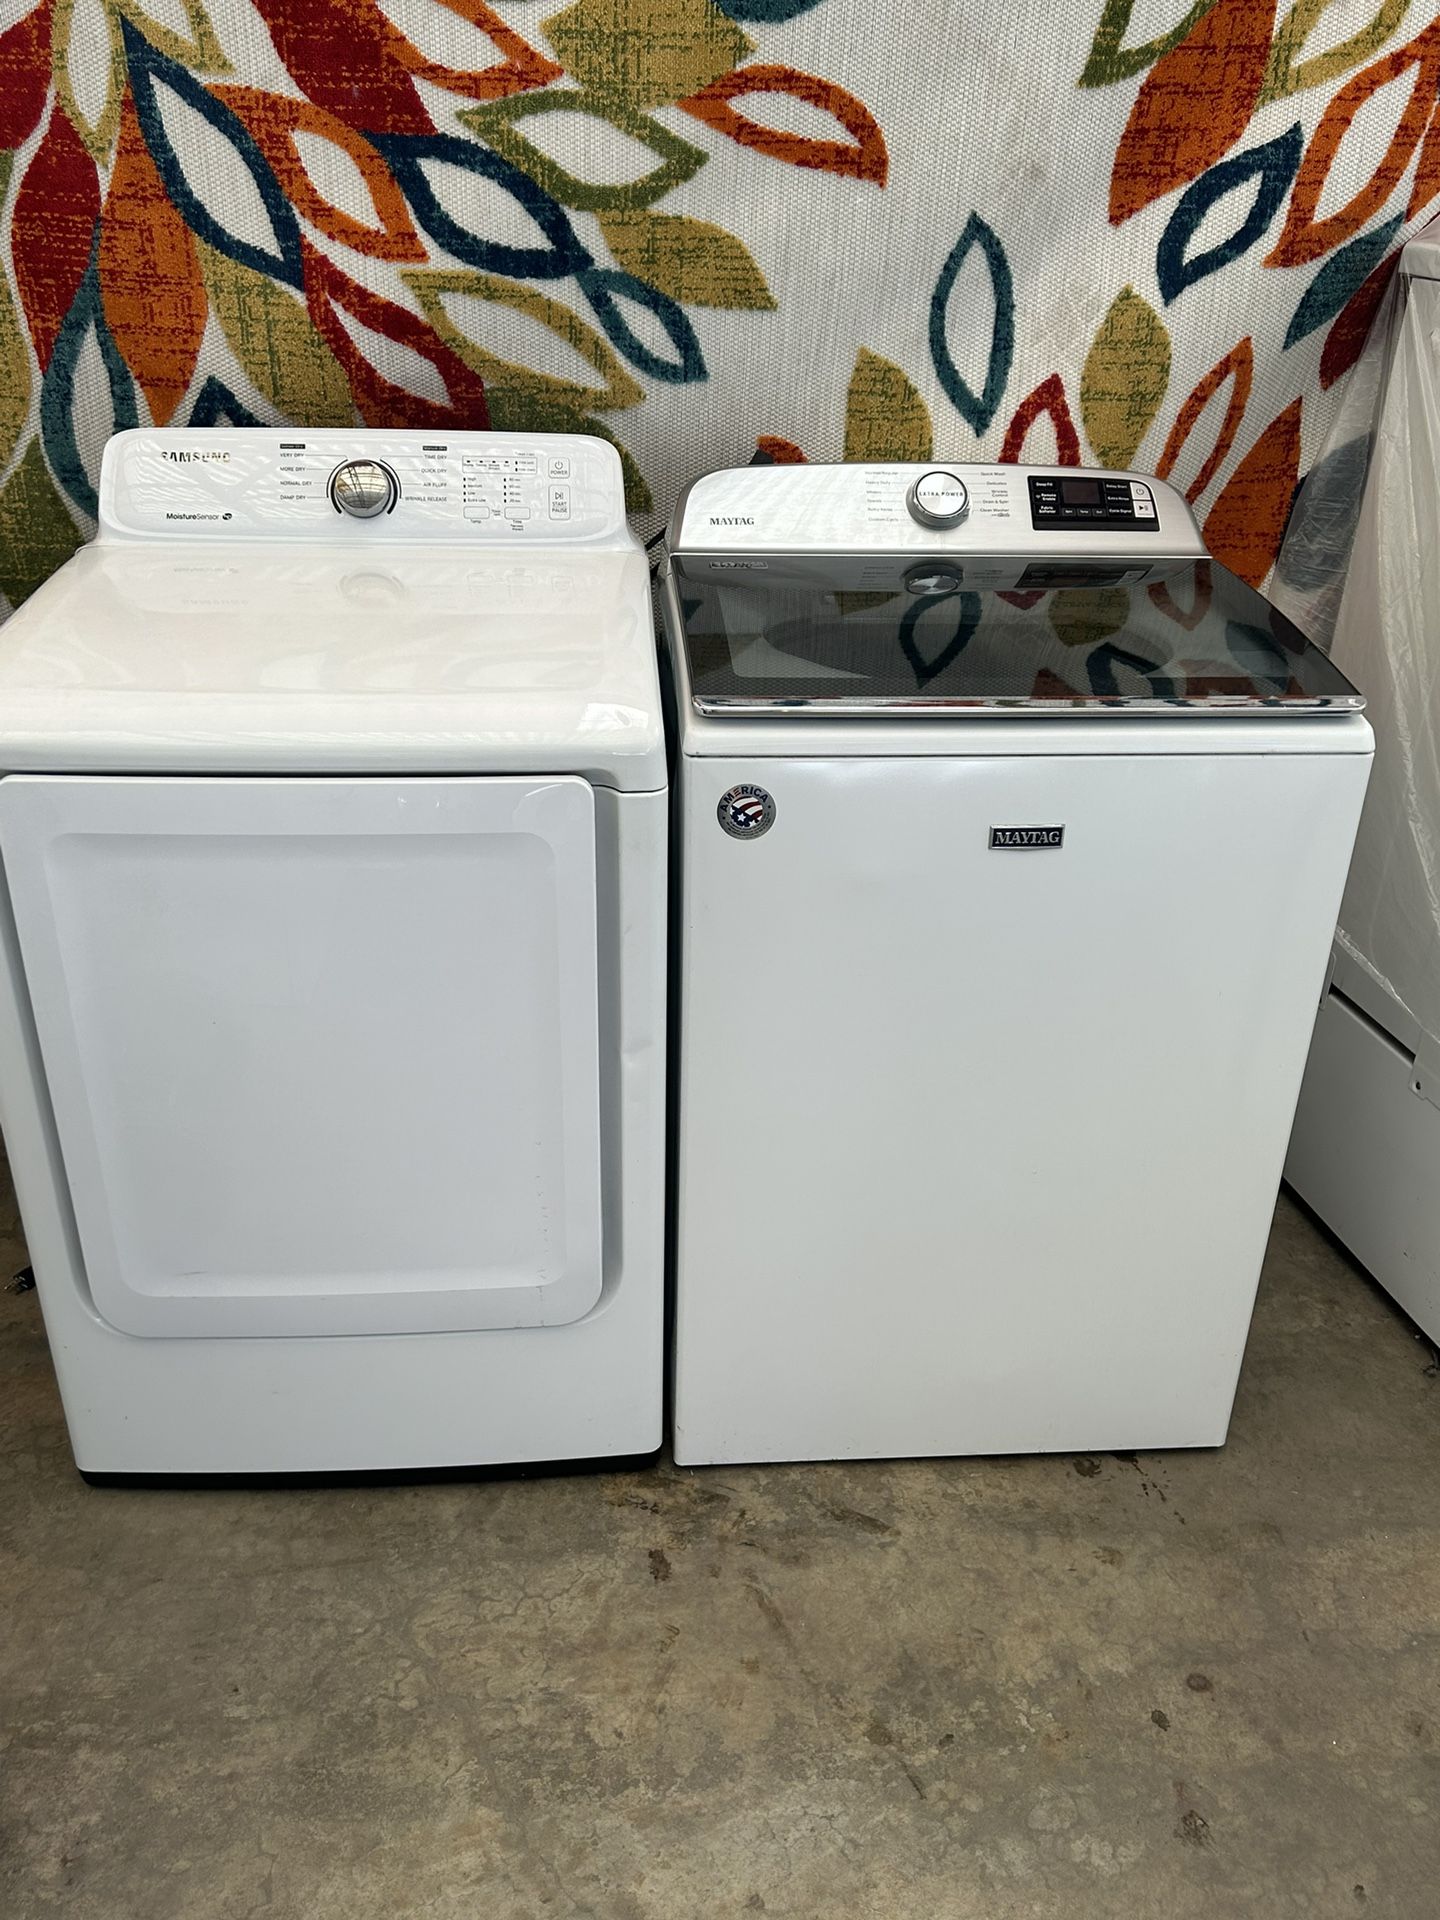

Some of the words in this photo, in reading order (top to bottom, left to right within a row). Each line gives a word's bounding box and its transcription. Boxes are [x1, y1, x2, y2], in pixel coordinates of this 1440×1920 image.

[161, 451, 231, 462] SAMSUNG
[166, 512, 220, 521] MoistureSensor
[709, 517, 755, 526] MAYTAG
[720, 786, 768, 812] AMERICA
[994, 830, 1060, 844] MAYTAG
